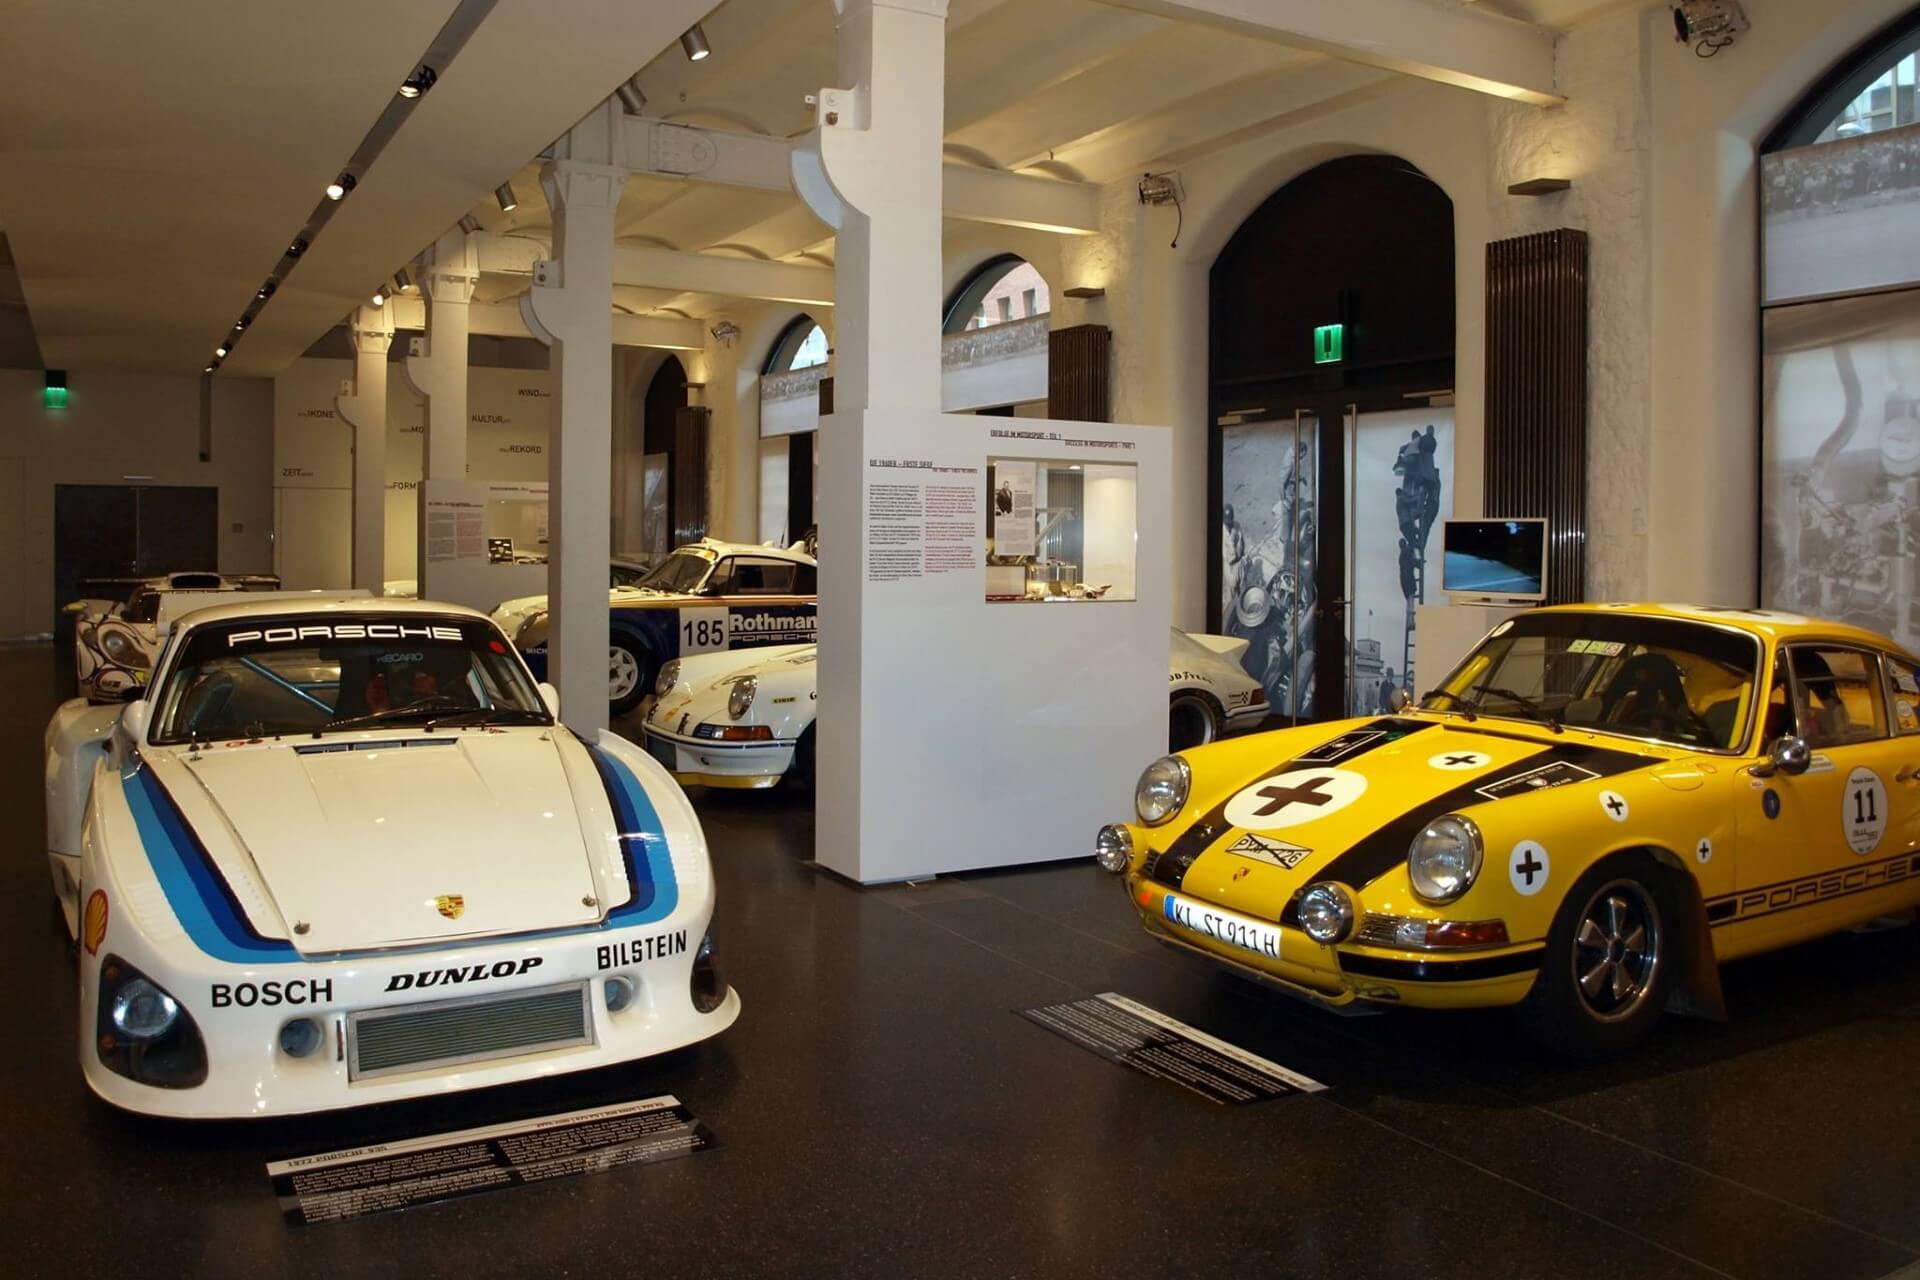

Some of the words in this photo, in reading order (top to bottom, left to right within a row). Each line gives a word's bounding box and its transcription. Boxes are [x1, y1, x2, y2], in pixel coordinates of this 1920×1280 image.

[518, 389, 539, 398] WIND
[306, 410, 335, 418] IKONE
[472, 415, 503, 423] KULTUR
[510, 445, 542, 454] REKORD
[283, 468, 301, 477] ZEIT
[228, 625, 463, 647] PORSCHE
[683, 620, 724, 646] 185
[1854, 788, 1877, 824] 11
[1740, 859, 1909, 915] PORSCHE
[1175, 903, 1195, 930] KL
[597, 930, 687, 970] BILSTEIN
[384, 956, 544, 992] DUNLOP
[211, 978, 334, 1009] BOSCH
